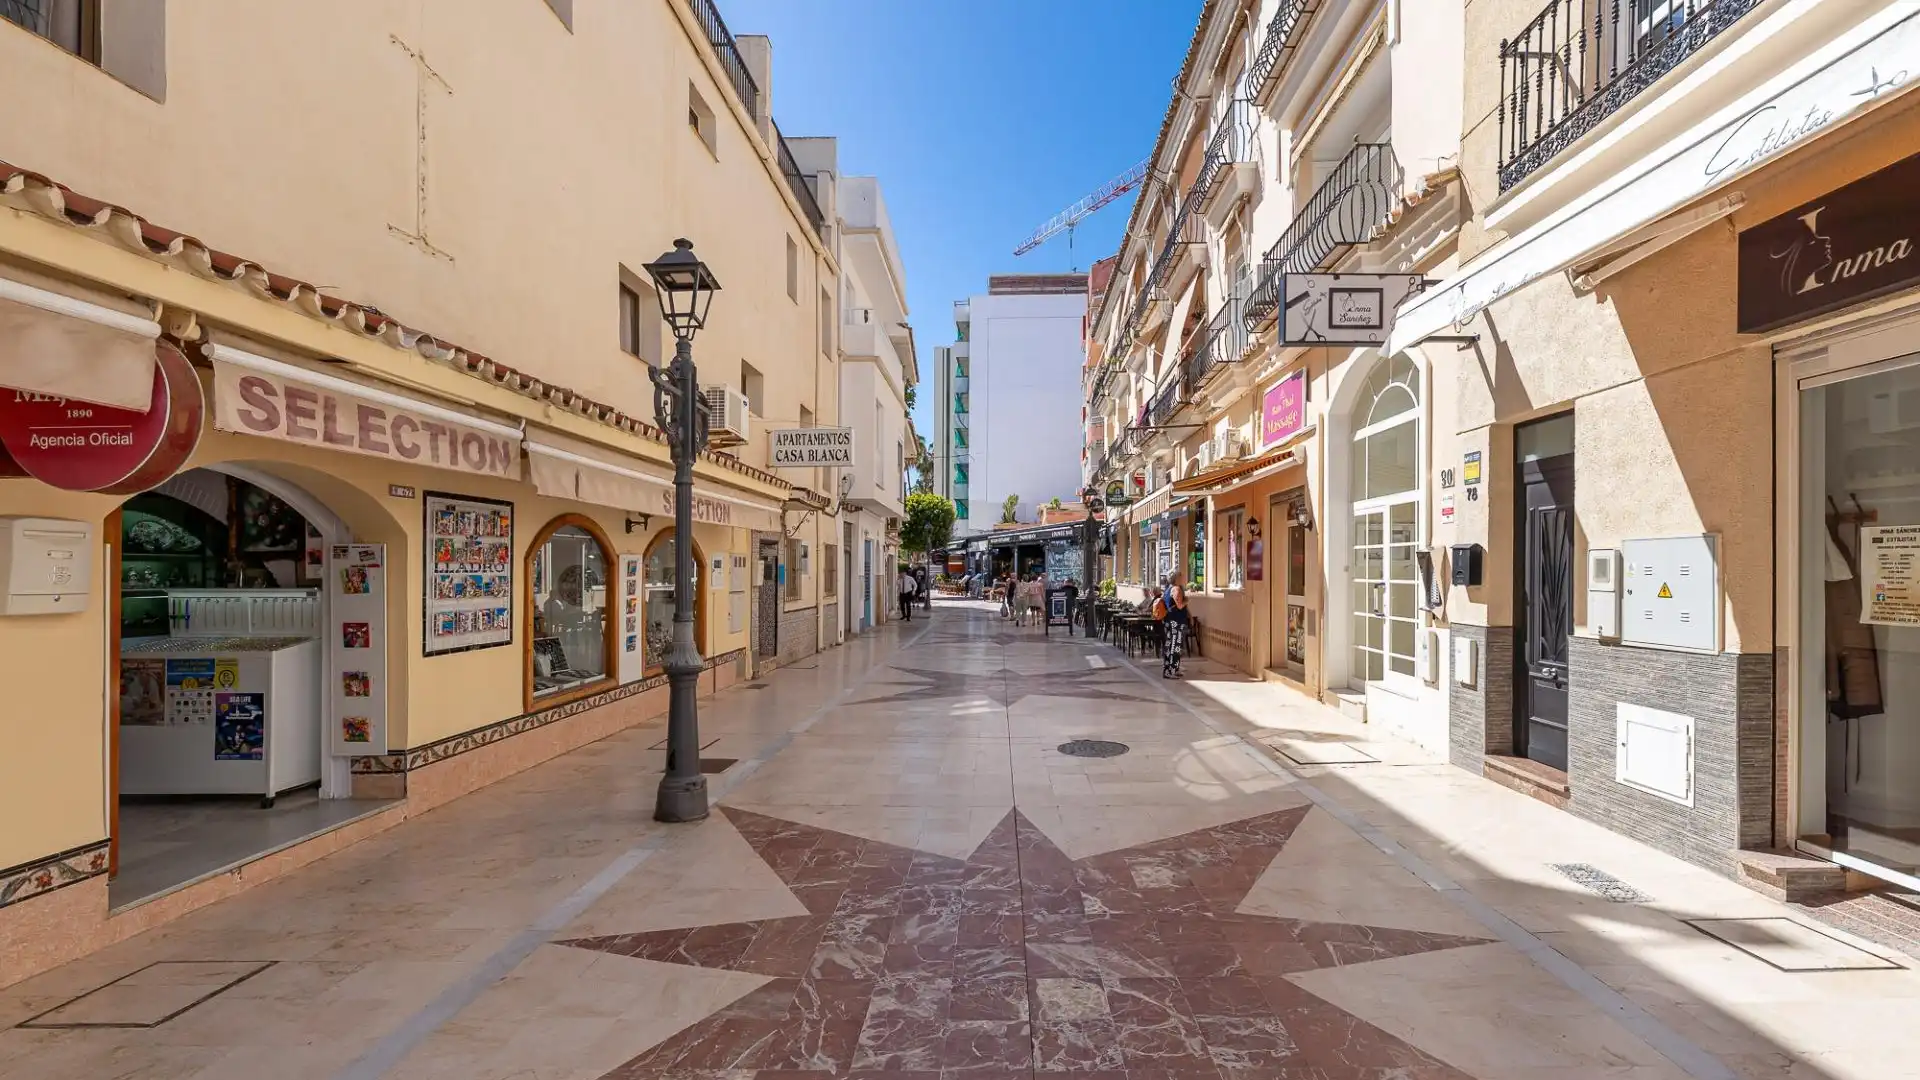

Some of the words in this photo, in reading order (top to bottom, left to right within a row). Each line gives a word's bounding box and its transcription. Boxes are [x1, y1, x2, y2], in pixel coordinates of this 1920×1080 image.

[1705, 104, 1835, 187] Estilistas
[67, 409, 93, 418] 1890
[236, 375, 511, 475] SELECTION
[30, 433, 85, 450] Agencia
[90, 432, 133, 446] Oficial
[776, 432, 850, 447] APARTAMENTOS
[776, 449, 804, 462] CASA
[808, 449, 850, 462] BLANCA
[1466, 486, 1478, 501] 78
